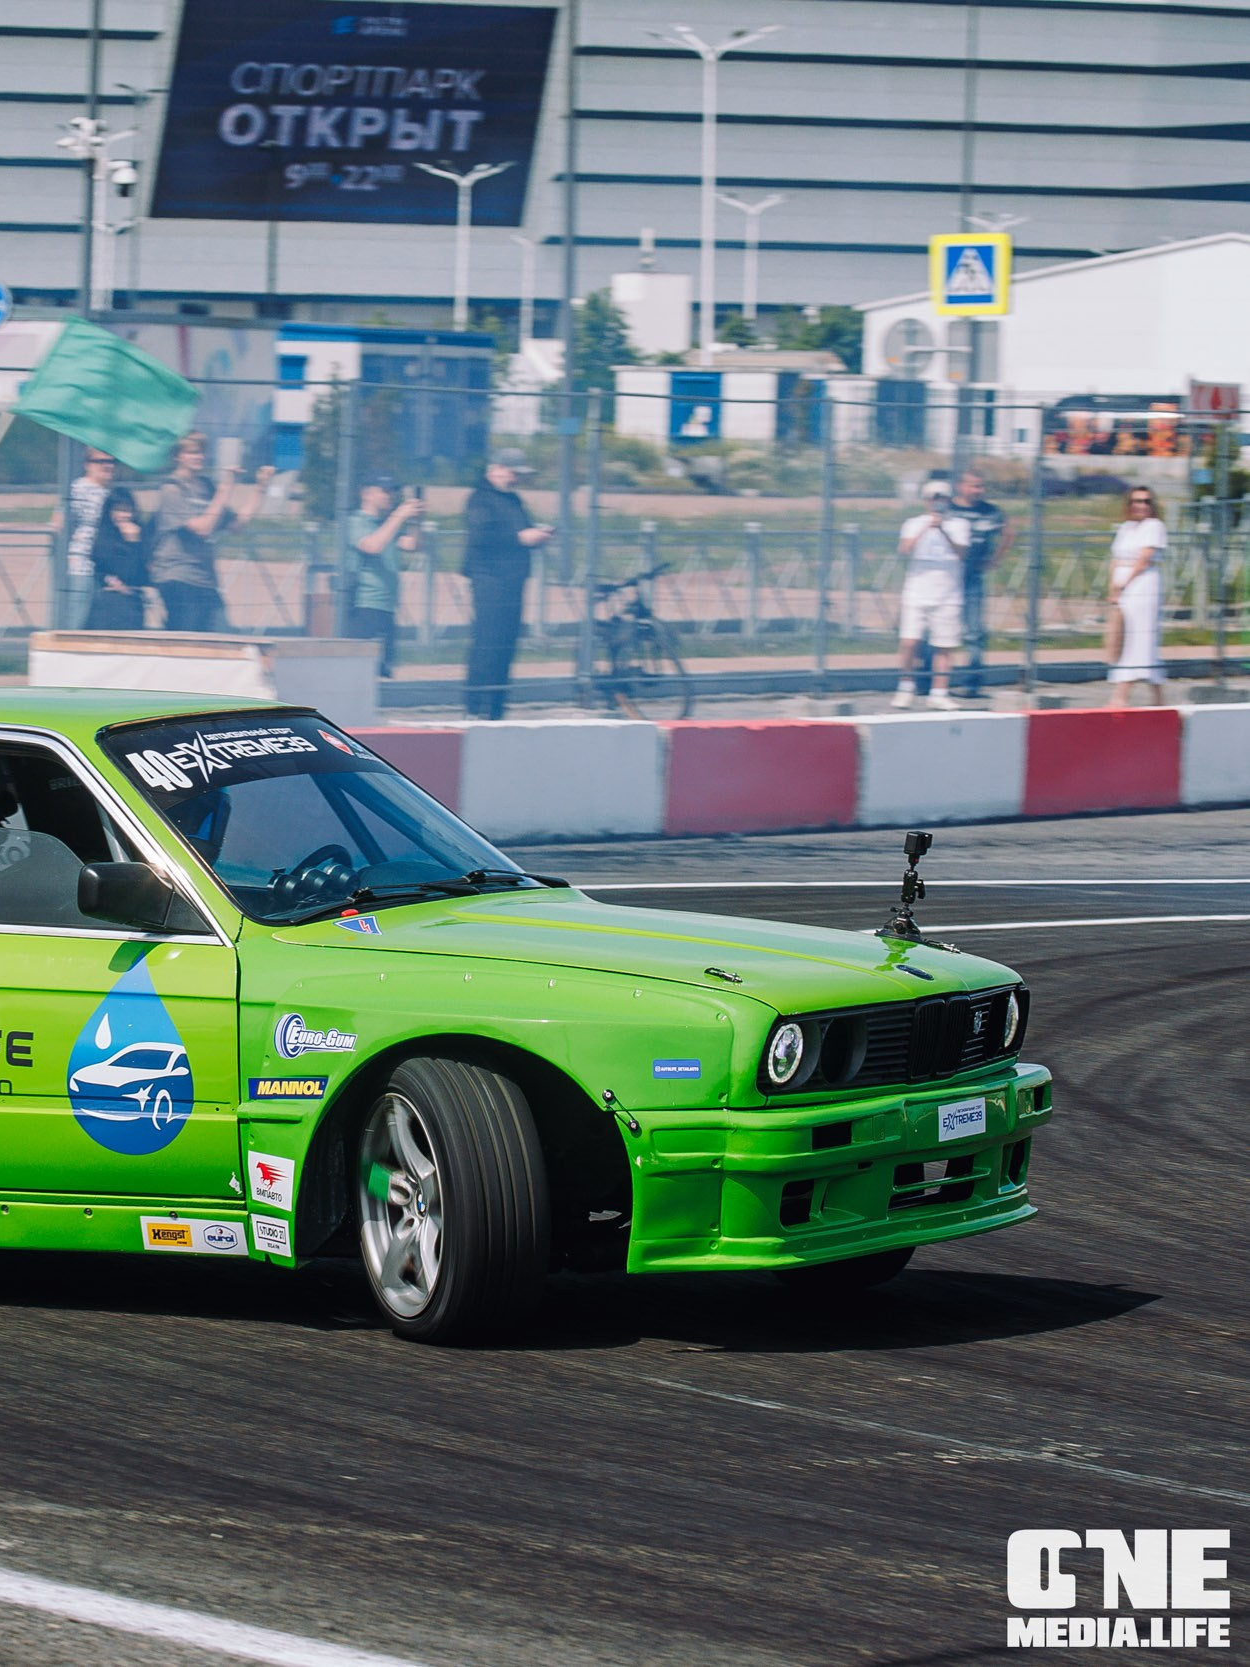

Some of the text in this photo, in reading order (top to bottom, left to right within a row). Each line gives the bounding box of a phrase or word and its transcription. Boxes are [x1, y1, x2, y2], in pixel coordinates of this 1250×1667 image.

[231, 62, 486, 100] СПОРТПАРК
[218, 104, 485, 151] ОТКРЫТ
[125, 750, 194, 792] 40
[257, 1081, 323, 1095] MANNOL
[256, 1187, 283, 1202] ВМПАВТО
[152, 1228, 187, 1240] Hengst
[207, 1234, 234, 1243] eurol
